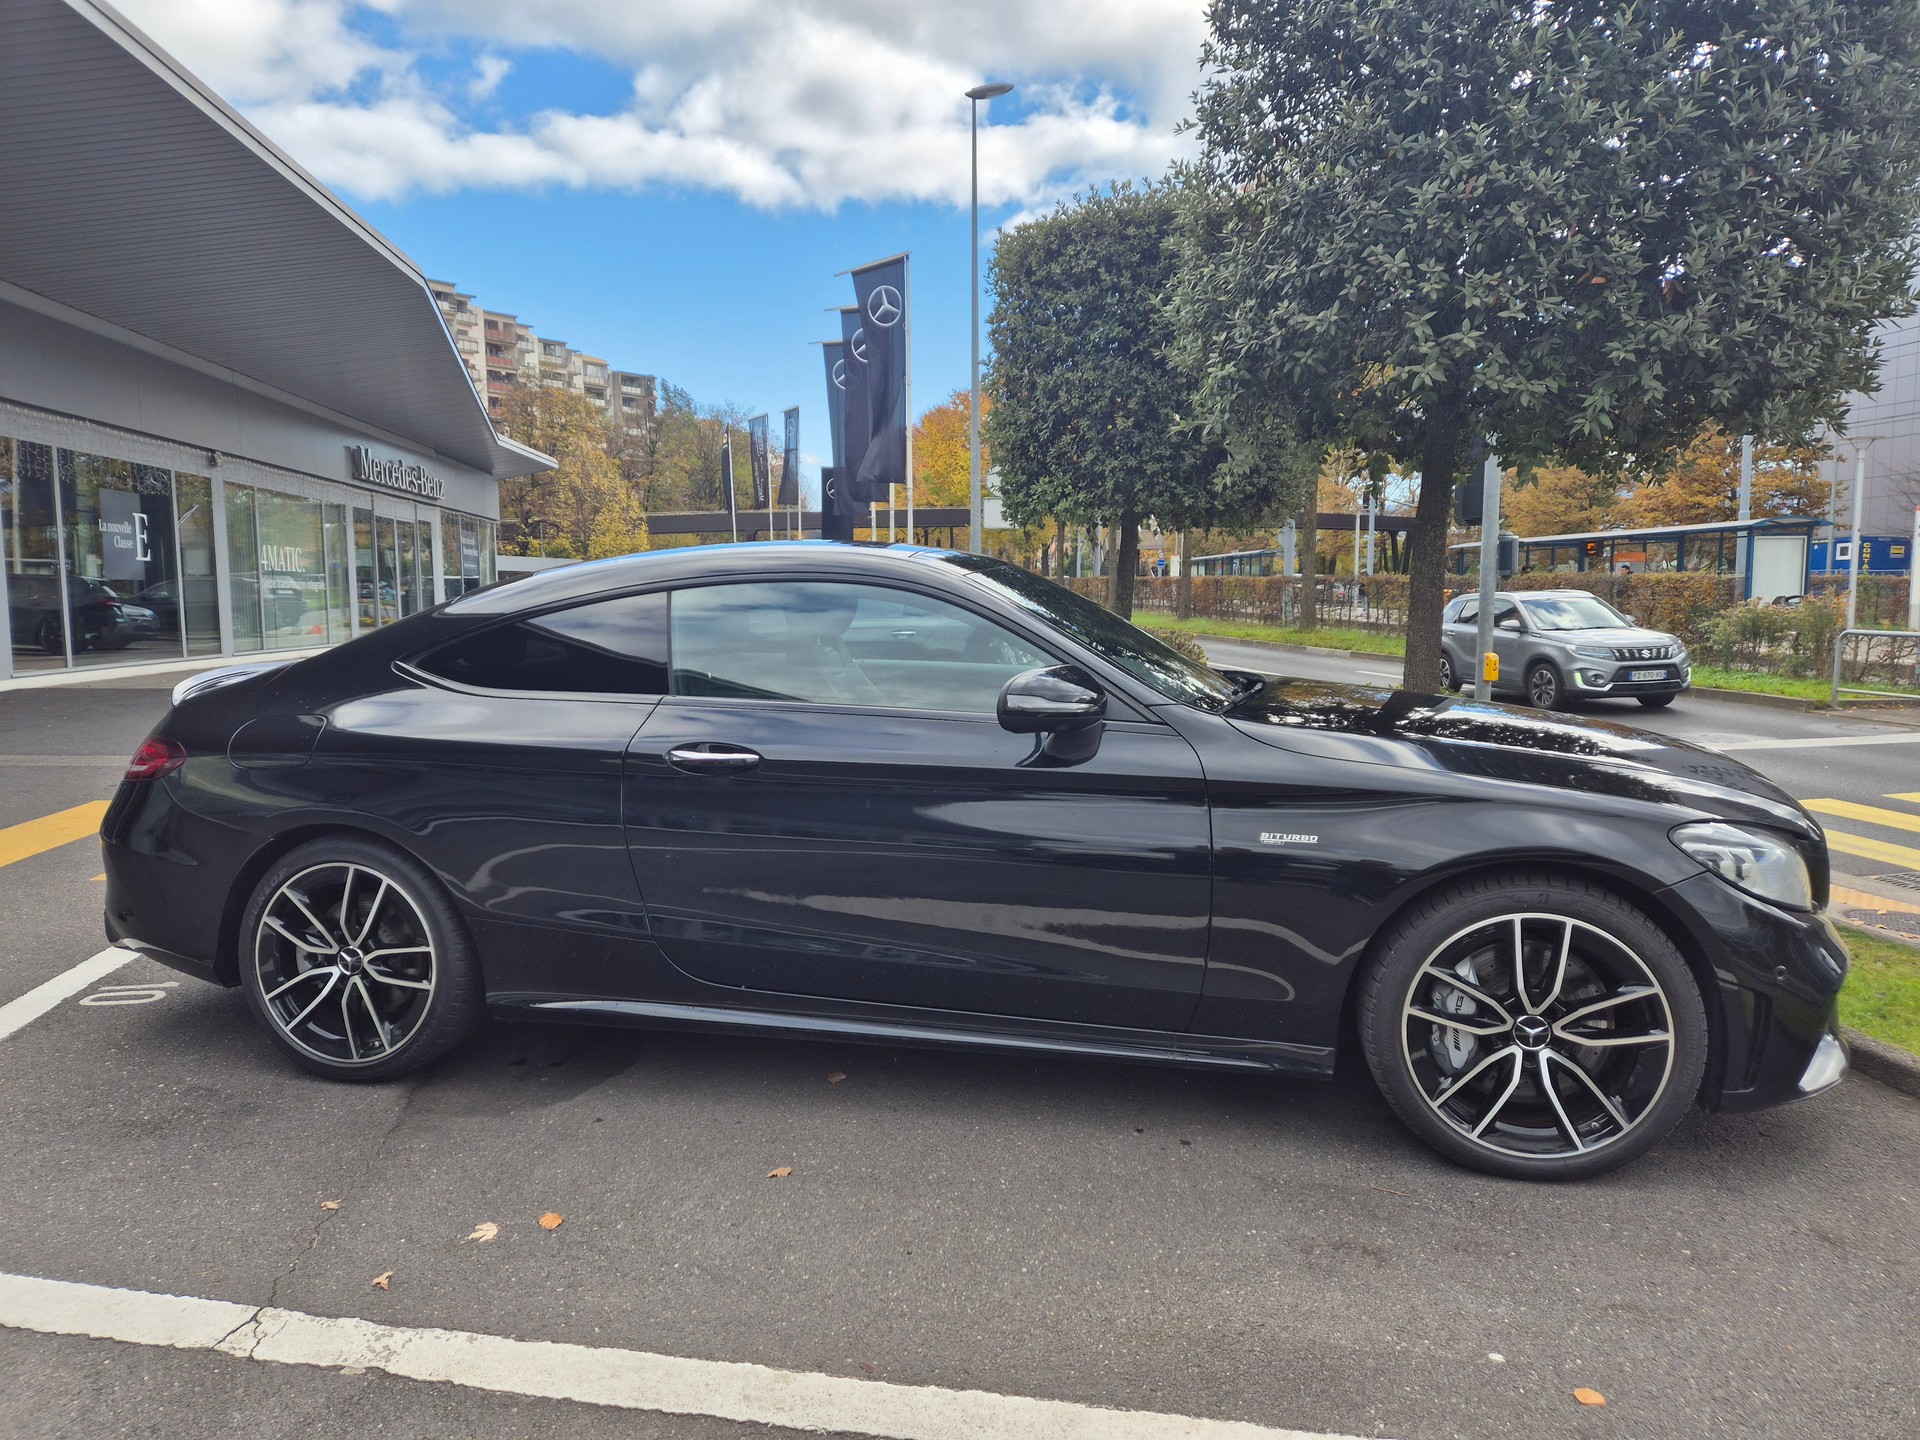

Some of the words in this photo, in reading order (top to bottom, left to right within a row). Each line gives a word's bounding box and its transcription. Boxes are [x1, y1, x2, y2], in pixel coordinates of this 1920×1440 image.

[360, 446, 445, 499] Mercedes-Benz
[98, 519, 107, 532] La
[108, 522, 132, 534] nouvelle
[114, 535, 133, 549] Classe
[132, 512, 151, 562] E
[1261, 832, 1318, 842] BITURBO
